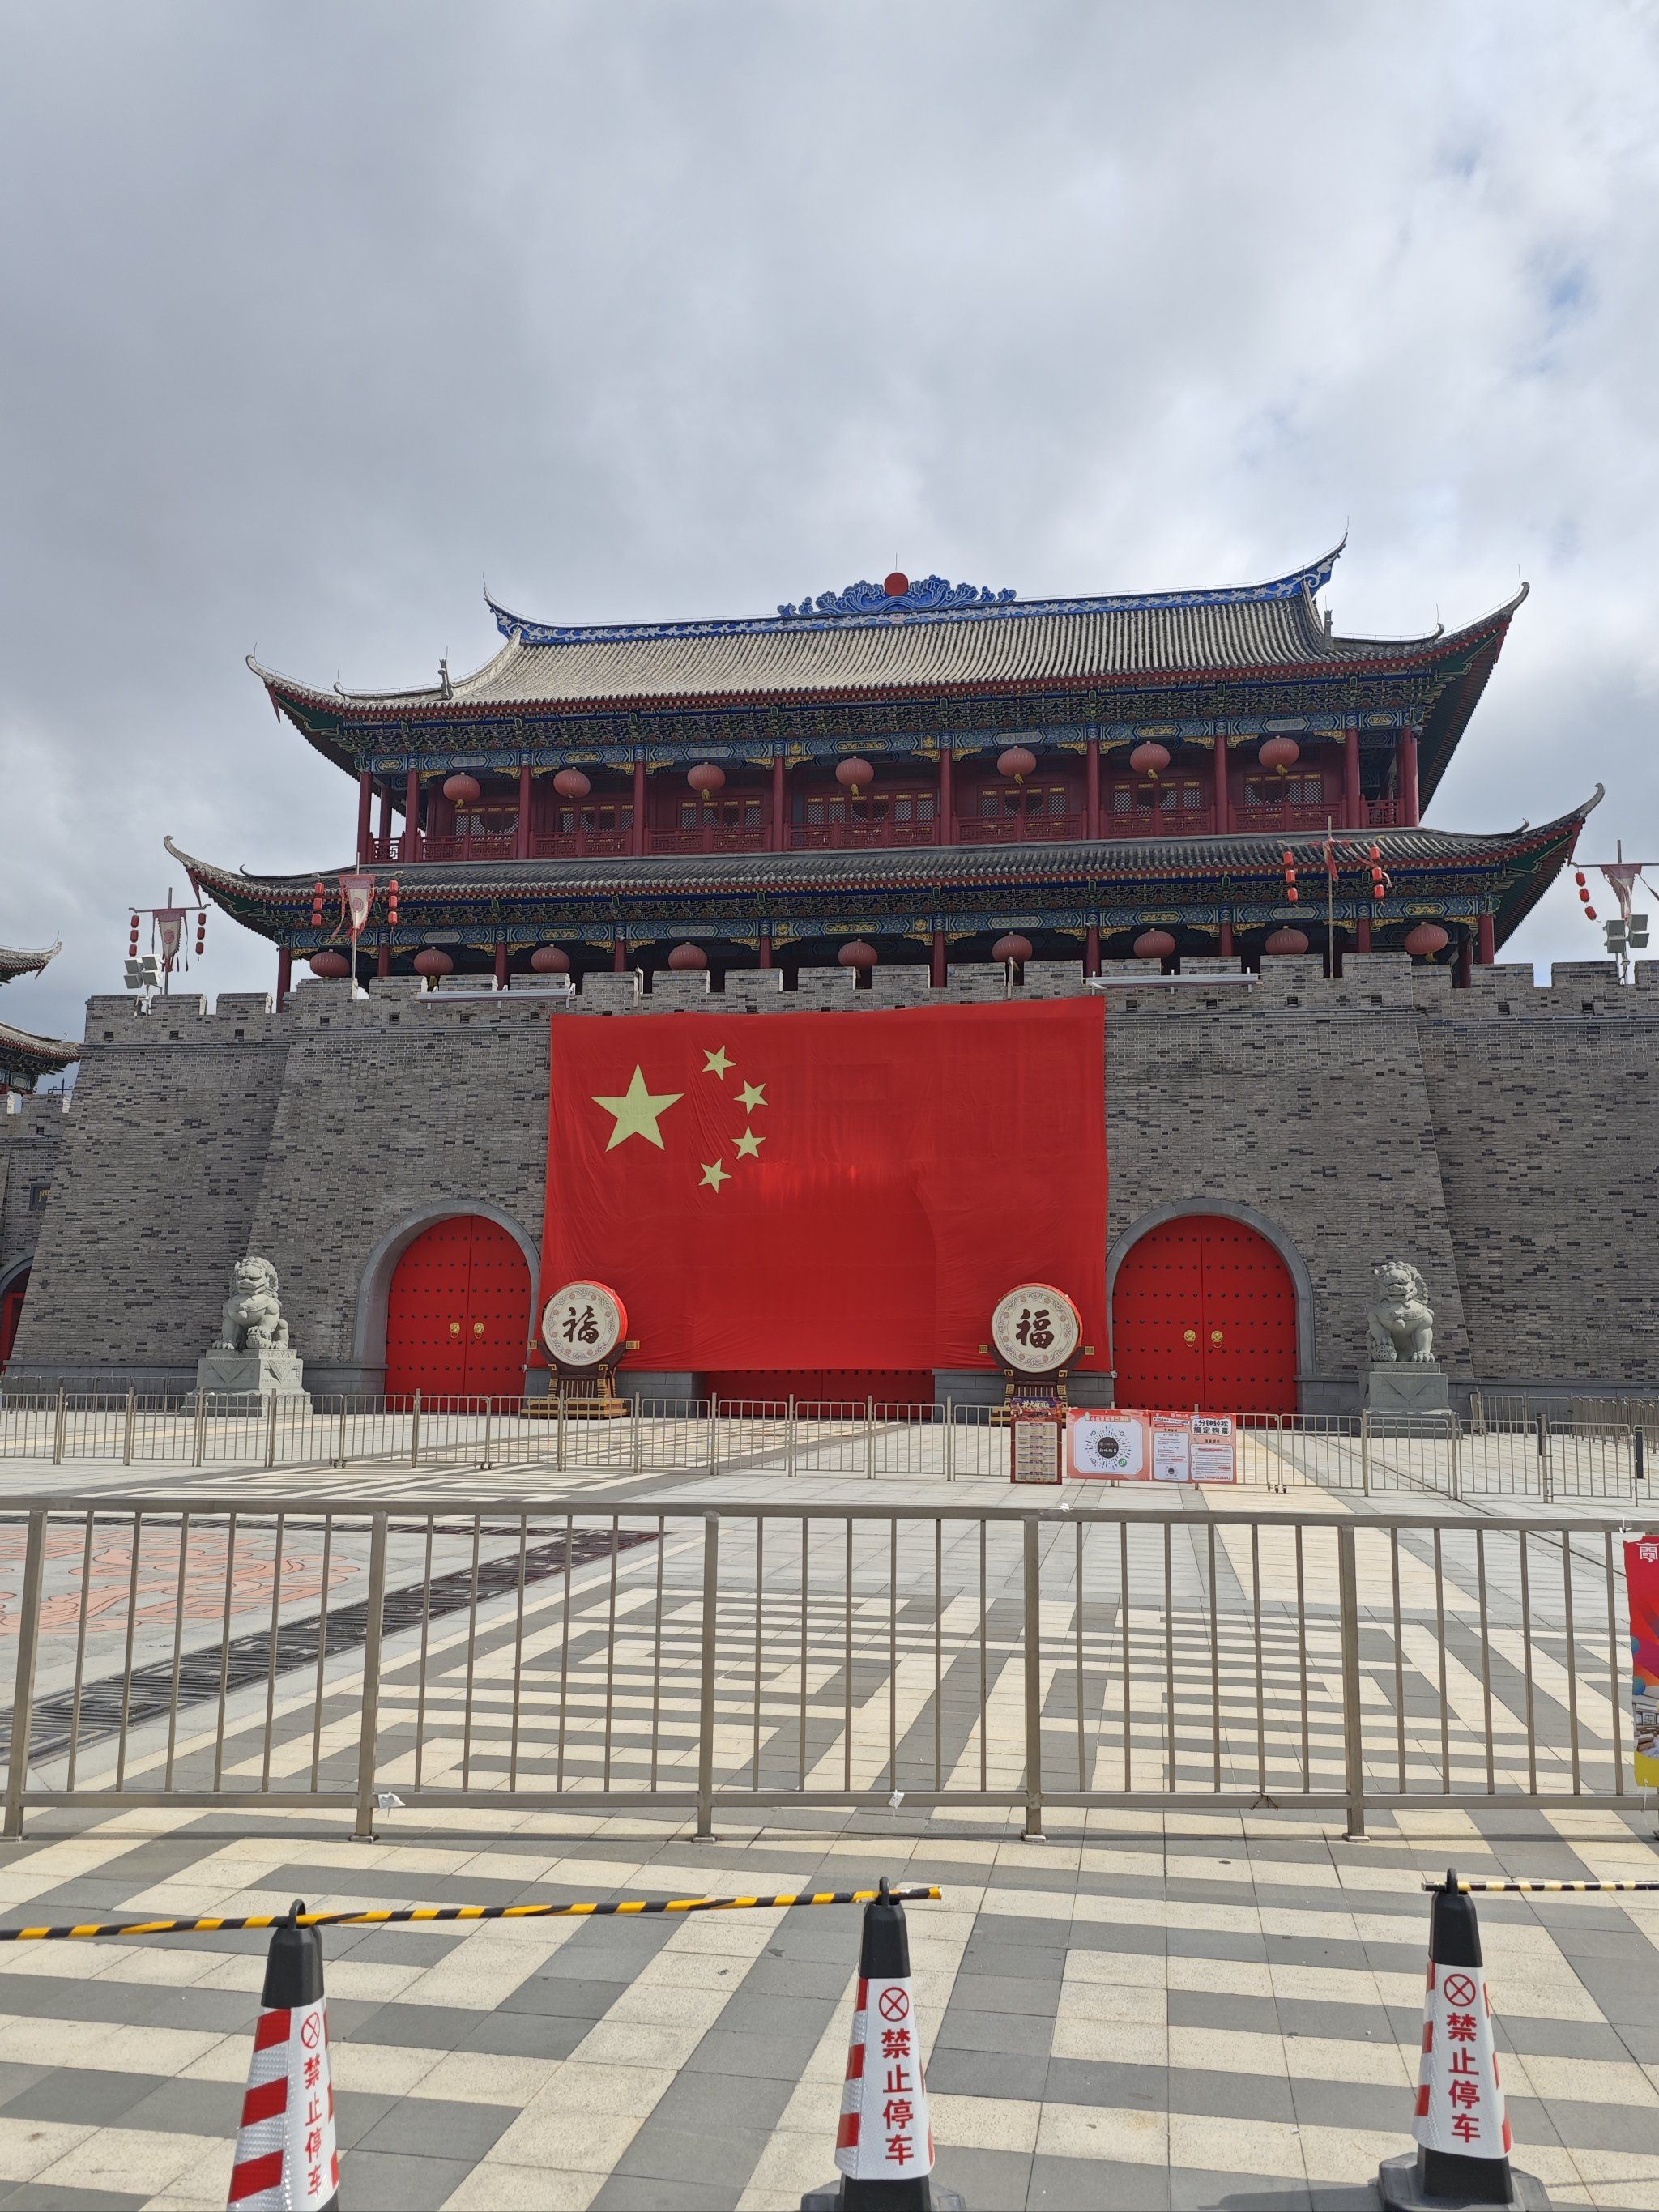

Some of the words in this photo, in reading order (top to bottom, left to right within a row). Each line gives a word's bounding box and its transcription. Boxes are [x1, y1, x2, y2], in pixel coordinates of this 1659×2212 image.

[562, 1305, 599, 1344] 福
[1016, 1308, 1054, 1349] 福
[1193, 1426, 1230, 1434] 搞定购票
[1194, 1419, 1229, 1427] 1分钟轻松
[881, 2027, 915, 2166] 禁止停车
[1446, 2012, 1481, 2143] 禁止停车
[303, 2052, 322, 2197] 禁止停车
